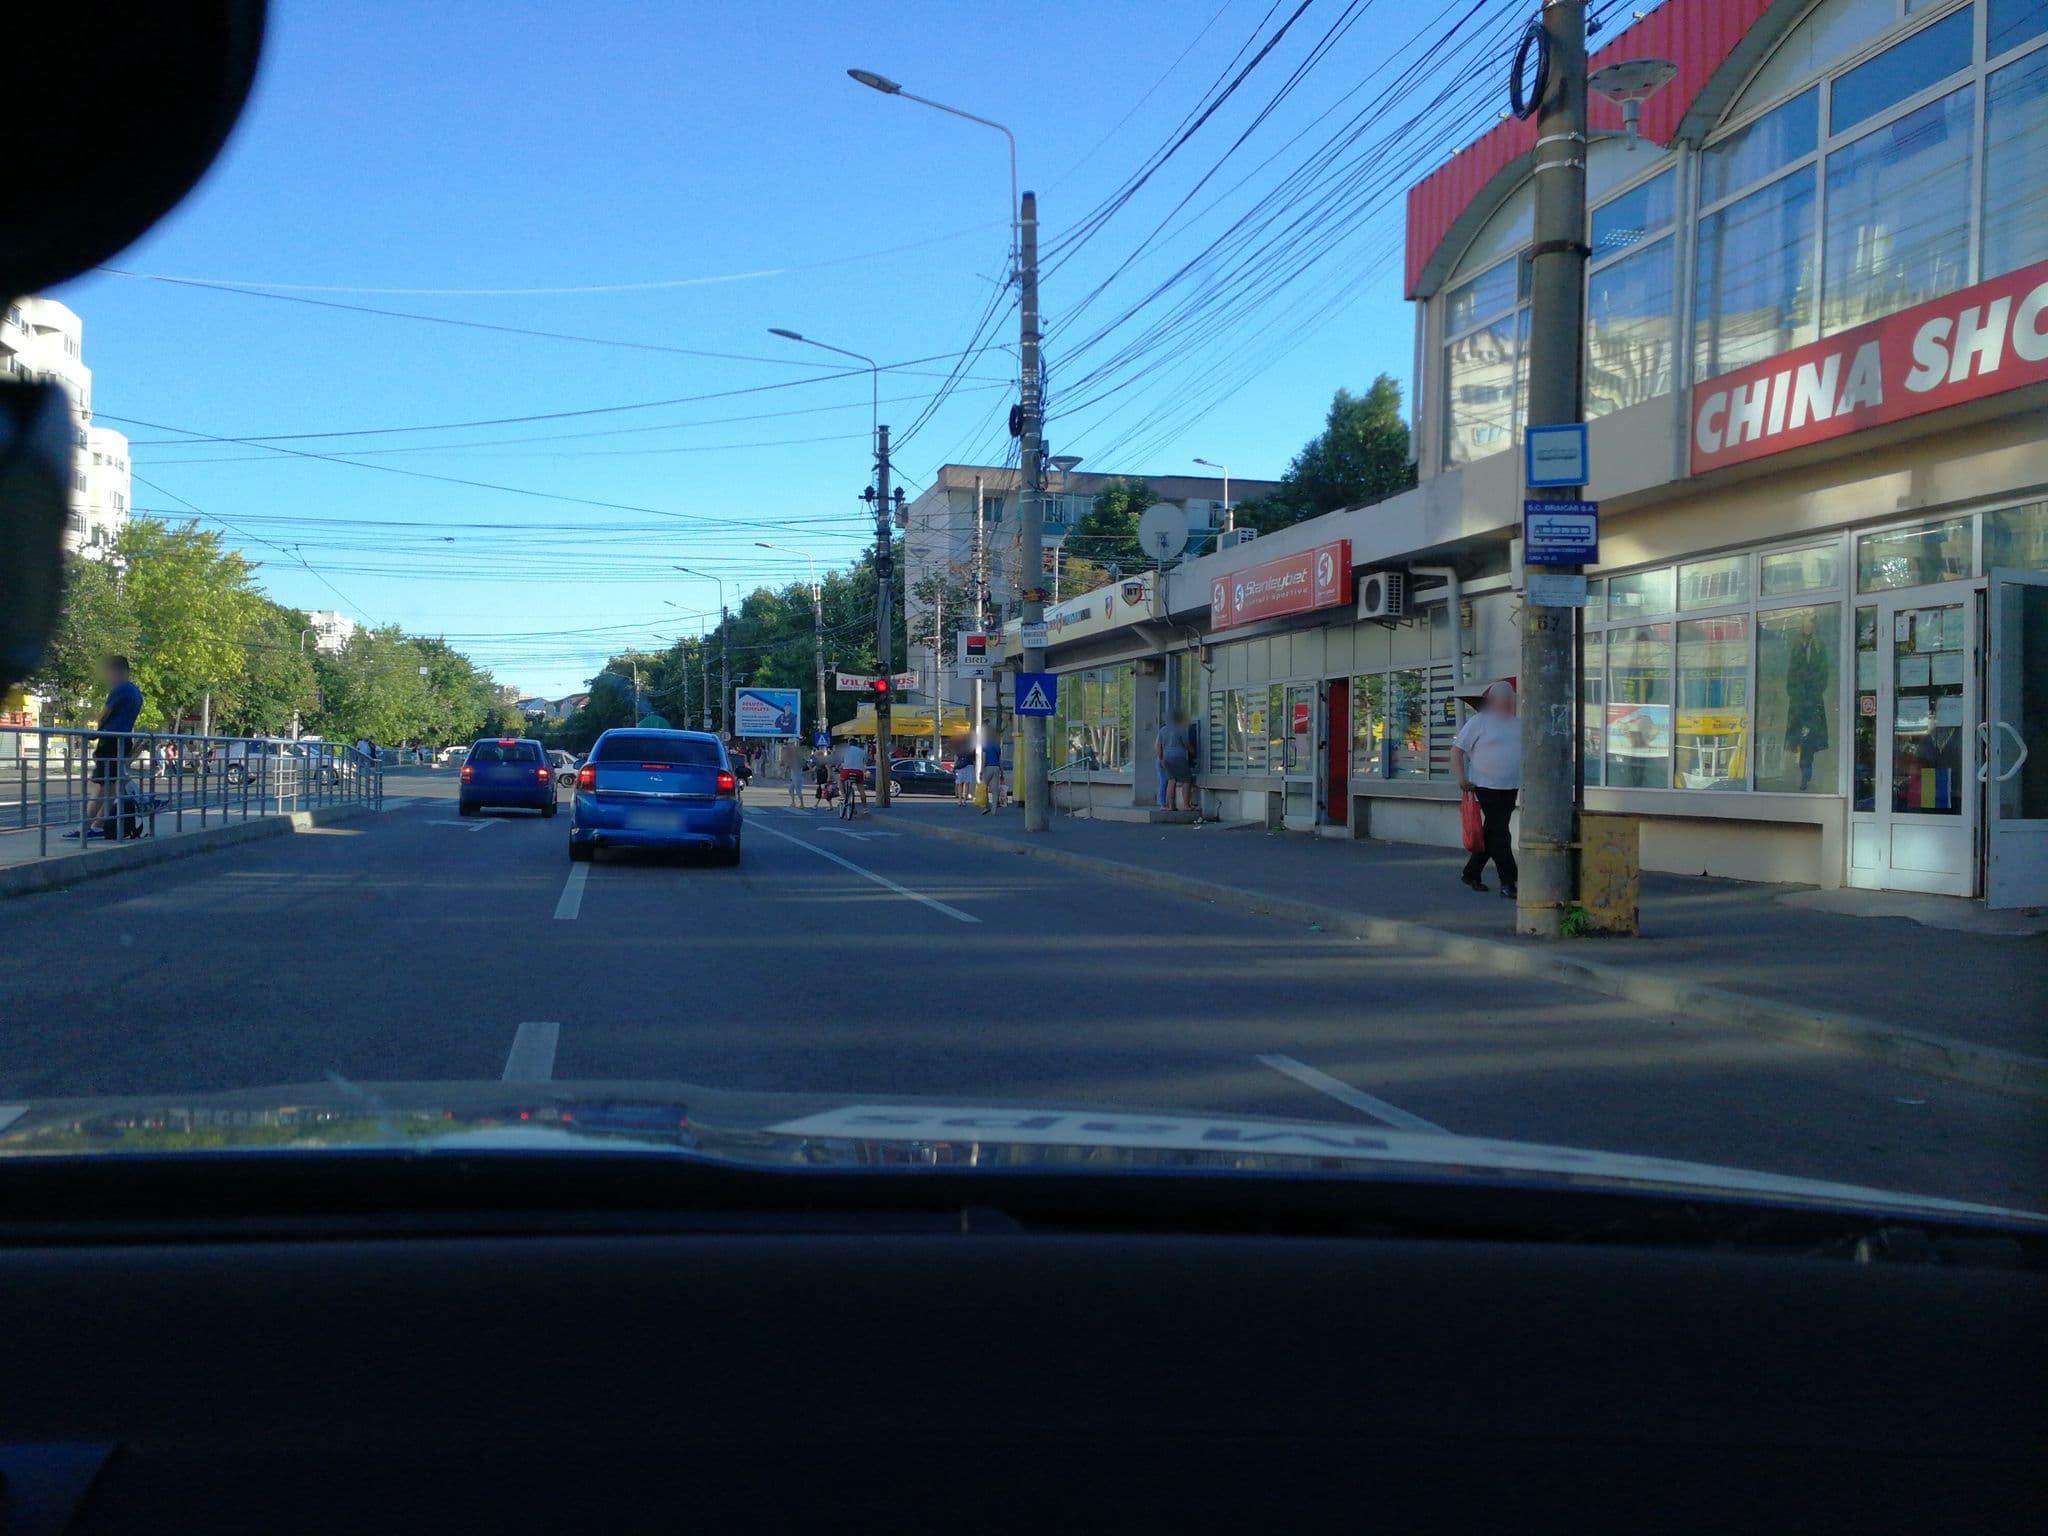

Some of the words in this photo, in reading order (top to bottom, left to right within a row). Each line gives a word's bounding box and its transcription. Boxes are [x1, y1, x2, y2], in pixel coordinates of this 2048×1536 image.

[1696, 340, 1884, 454] CHINA
[1245, 568, 1309, 597] Stanleybet
[964, 656, 988, 664] BRD
